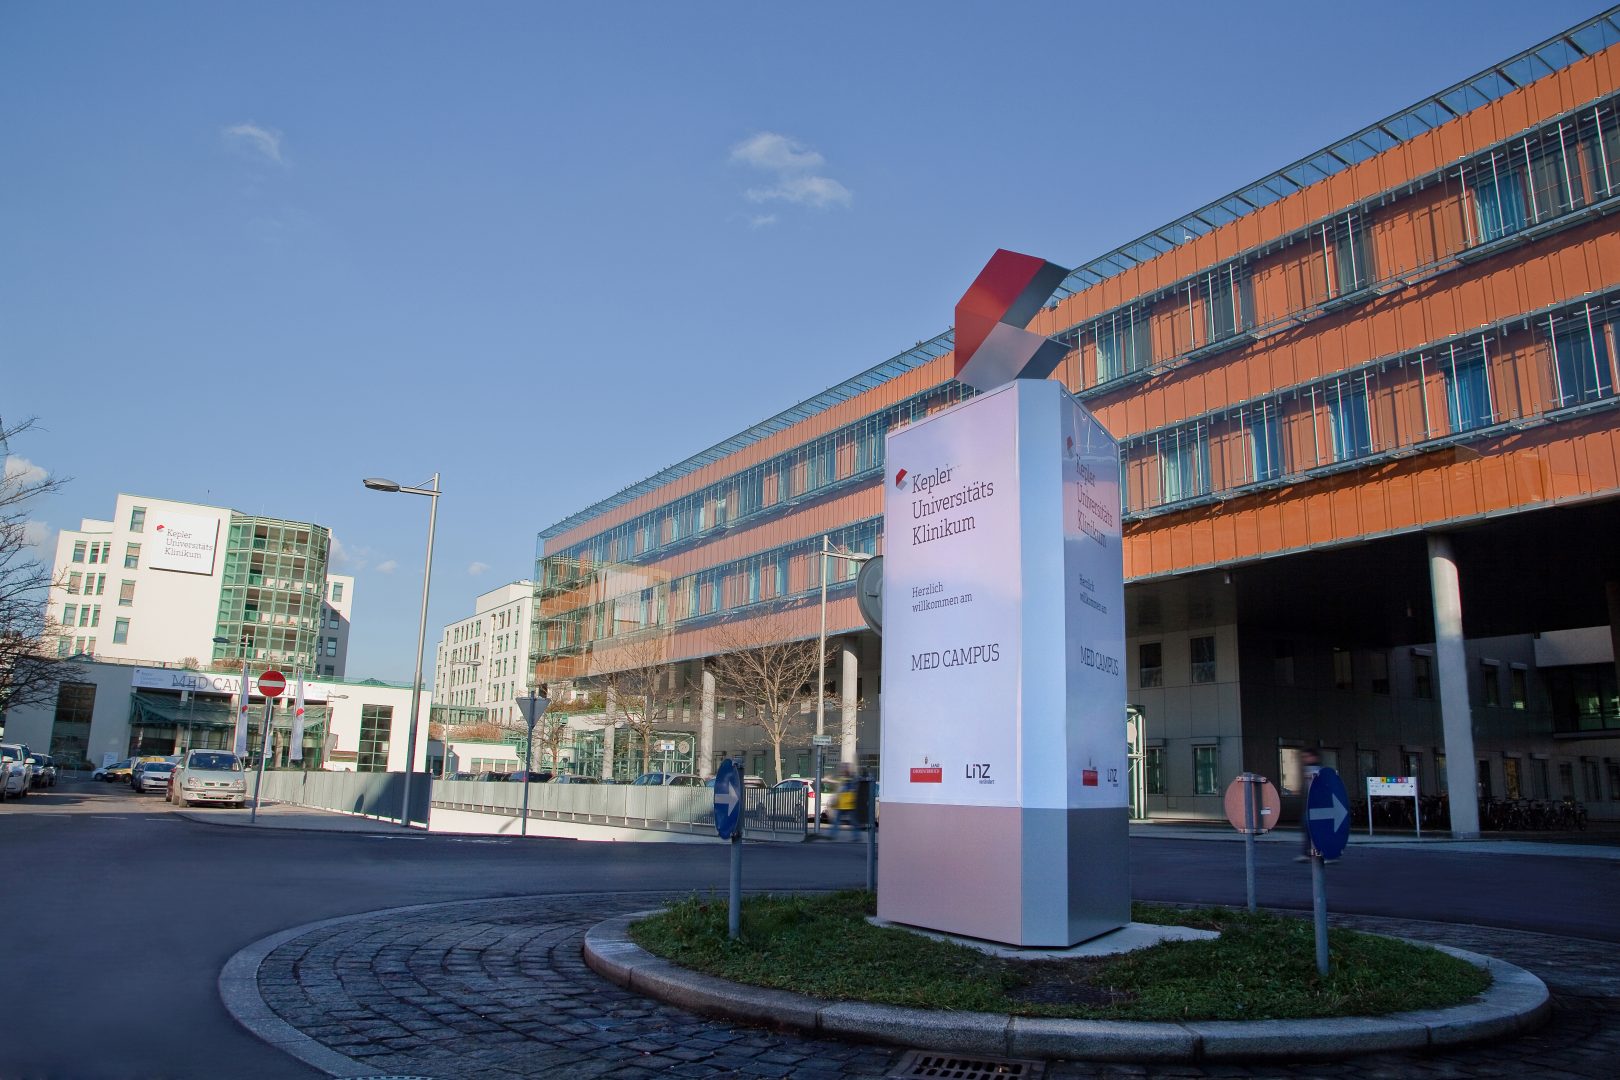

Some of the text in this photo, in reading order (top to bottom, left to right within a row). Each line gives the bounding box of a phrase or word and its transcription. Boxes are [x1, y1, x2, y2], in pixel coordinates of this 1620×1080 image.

[912, 467, 953, 494] Kepler
[912, 481, 994, 519] Universitäts
[167, 528, 192, 539] Kepler
[912, 515, 976, 546] Klinikum
[164, 547, 202, 559] Klinikum
[912, 581, 944, 598] Herzlich
[912, 593, 973, 613] willkommen am
[911, 643, 1000, 671] MED CAMPUS
[1080, 645, 1119, 676] MED CAMPUS
[172, 674, 209, 690] MED
